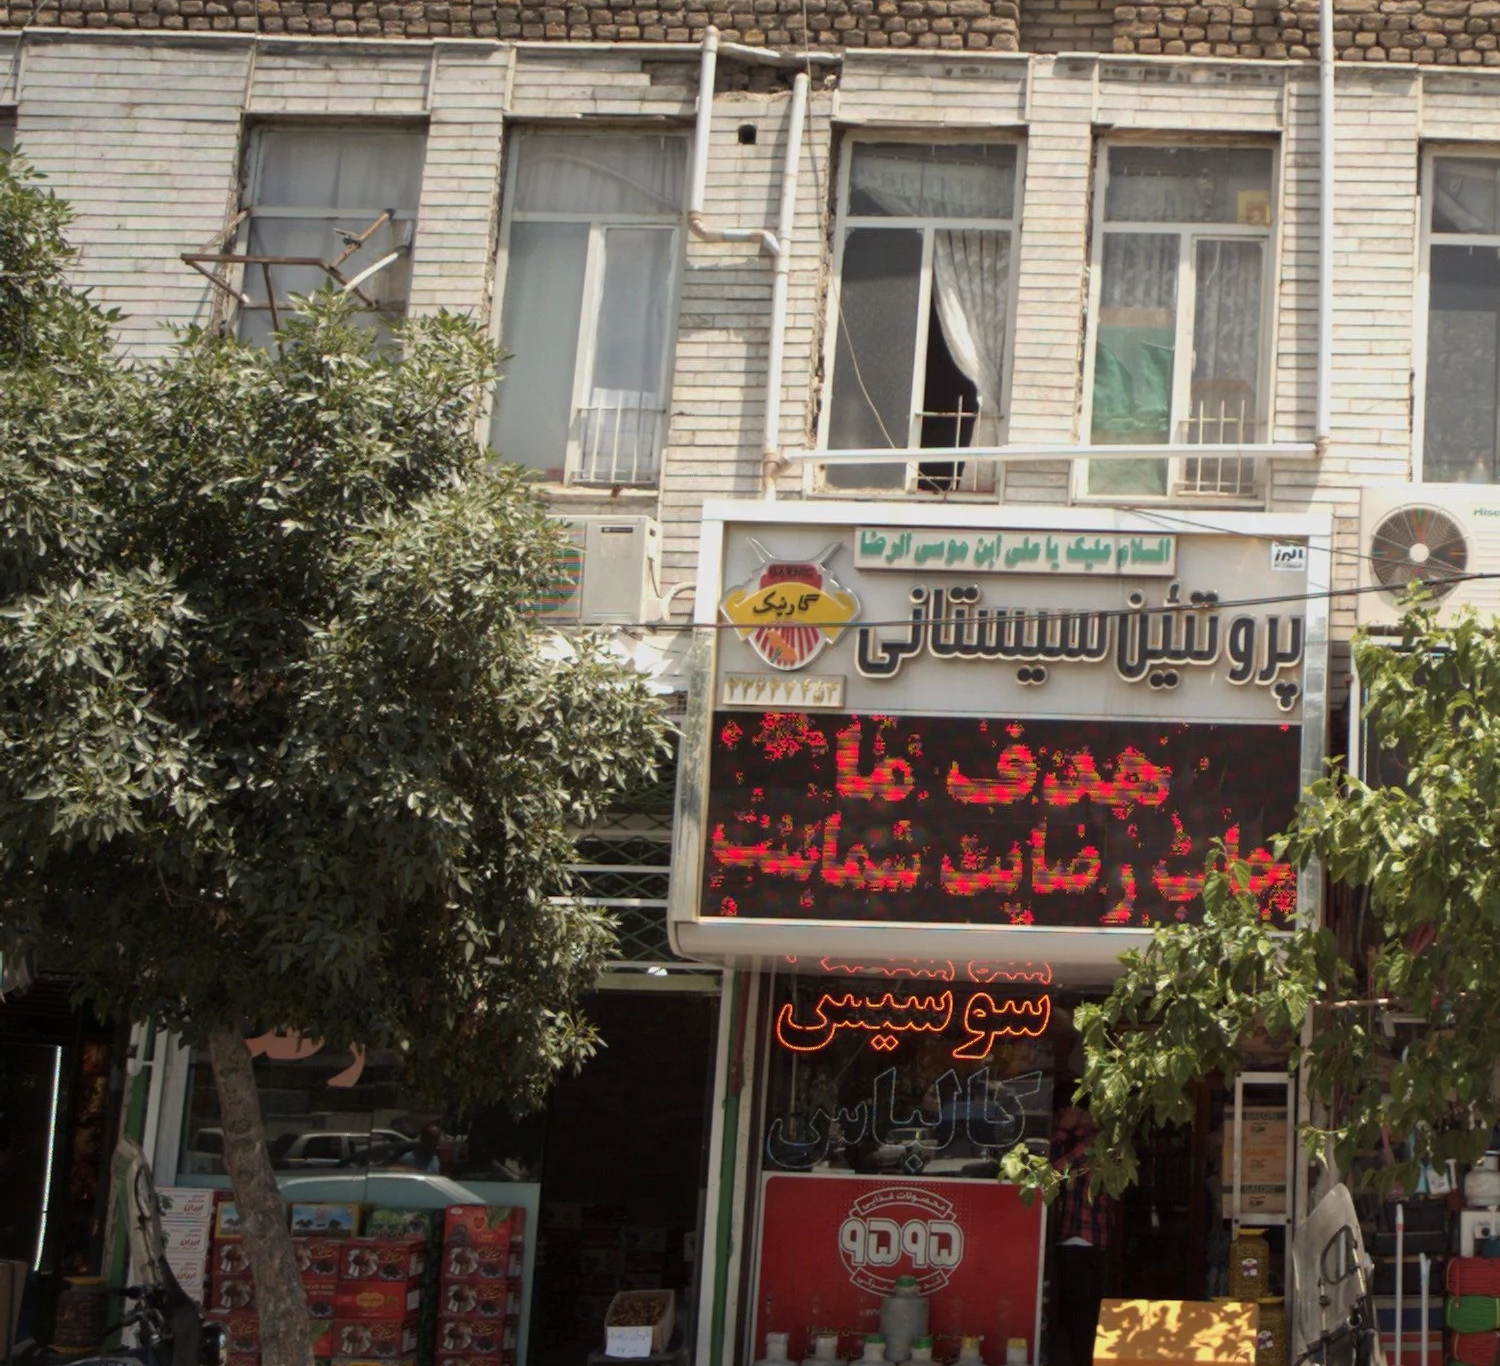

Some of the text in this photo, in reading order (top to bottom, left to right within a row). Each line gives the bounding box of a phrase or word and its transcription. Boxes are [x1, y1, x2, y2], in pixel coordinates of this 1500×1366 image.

[853, 579, 1305, 712] پروتئین سیستانی
[776, 989, 1052, 1060] سوسیس
[767, 1066, 1043, 1170] کالباس
